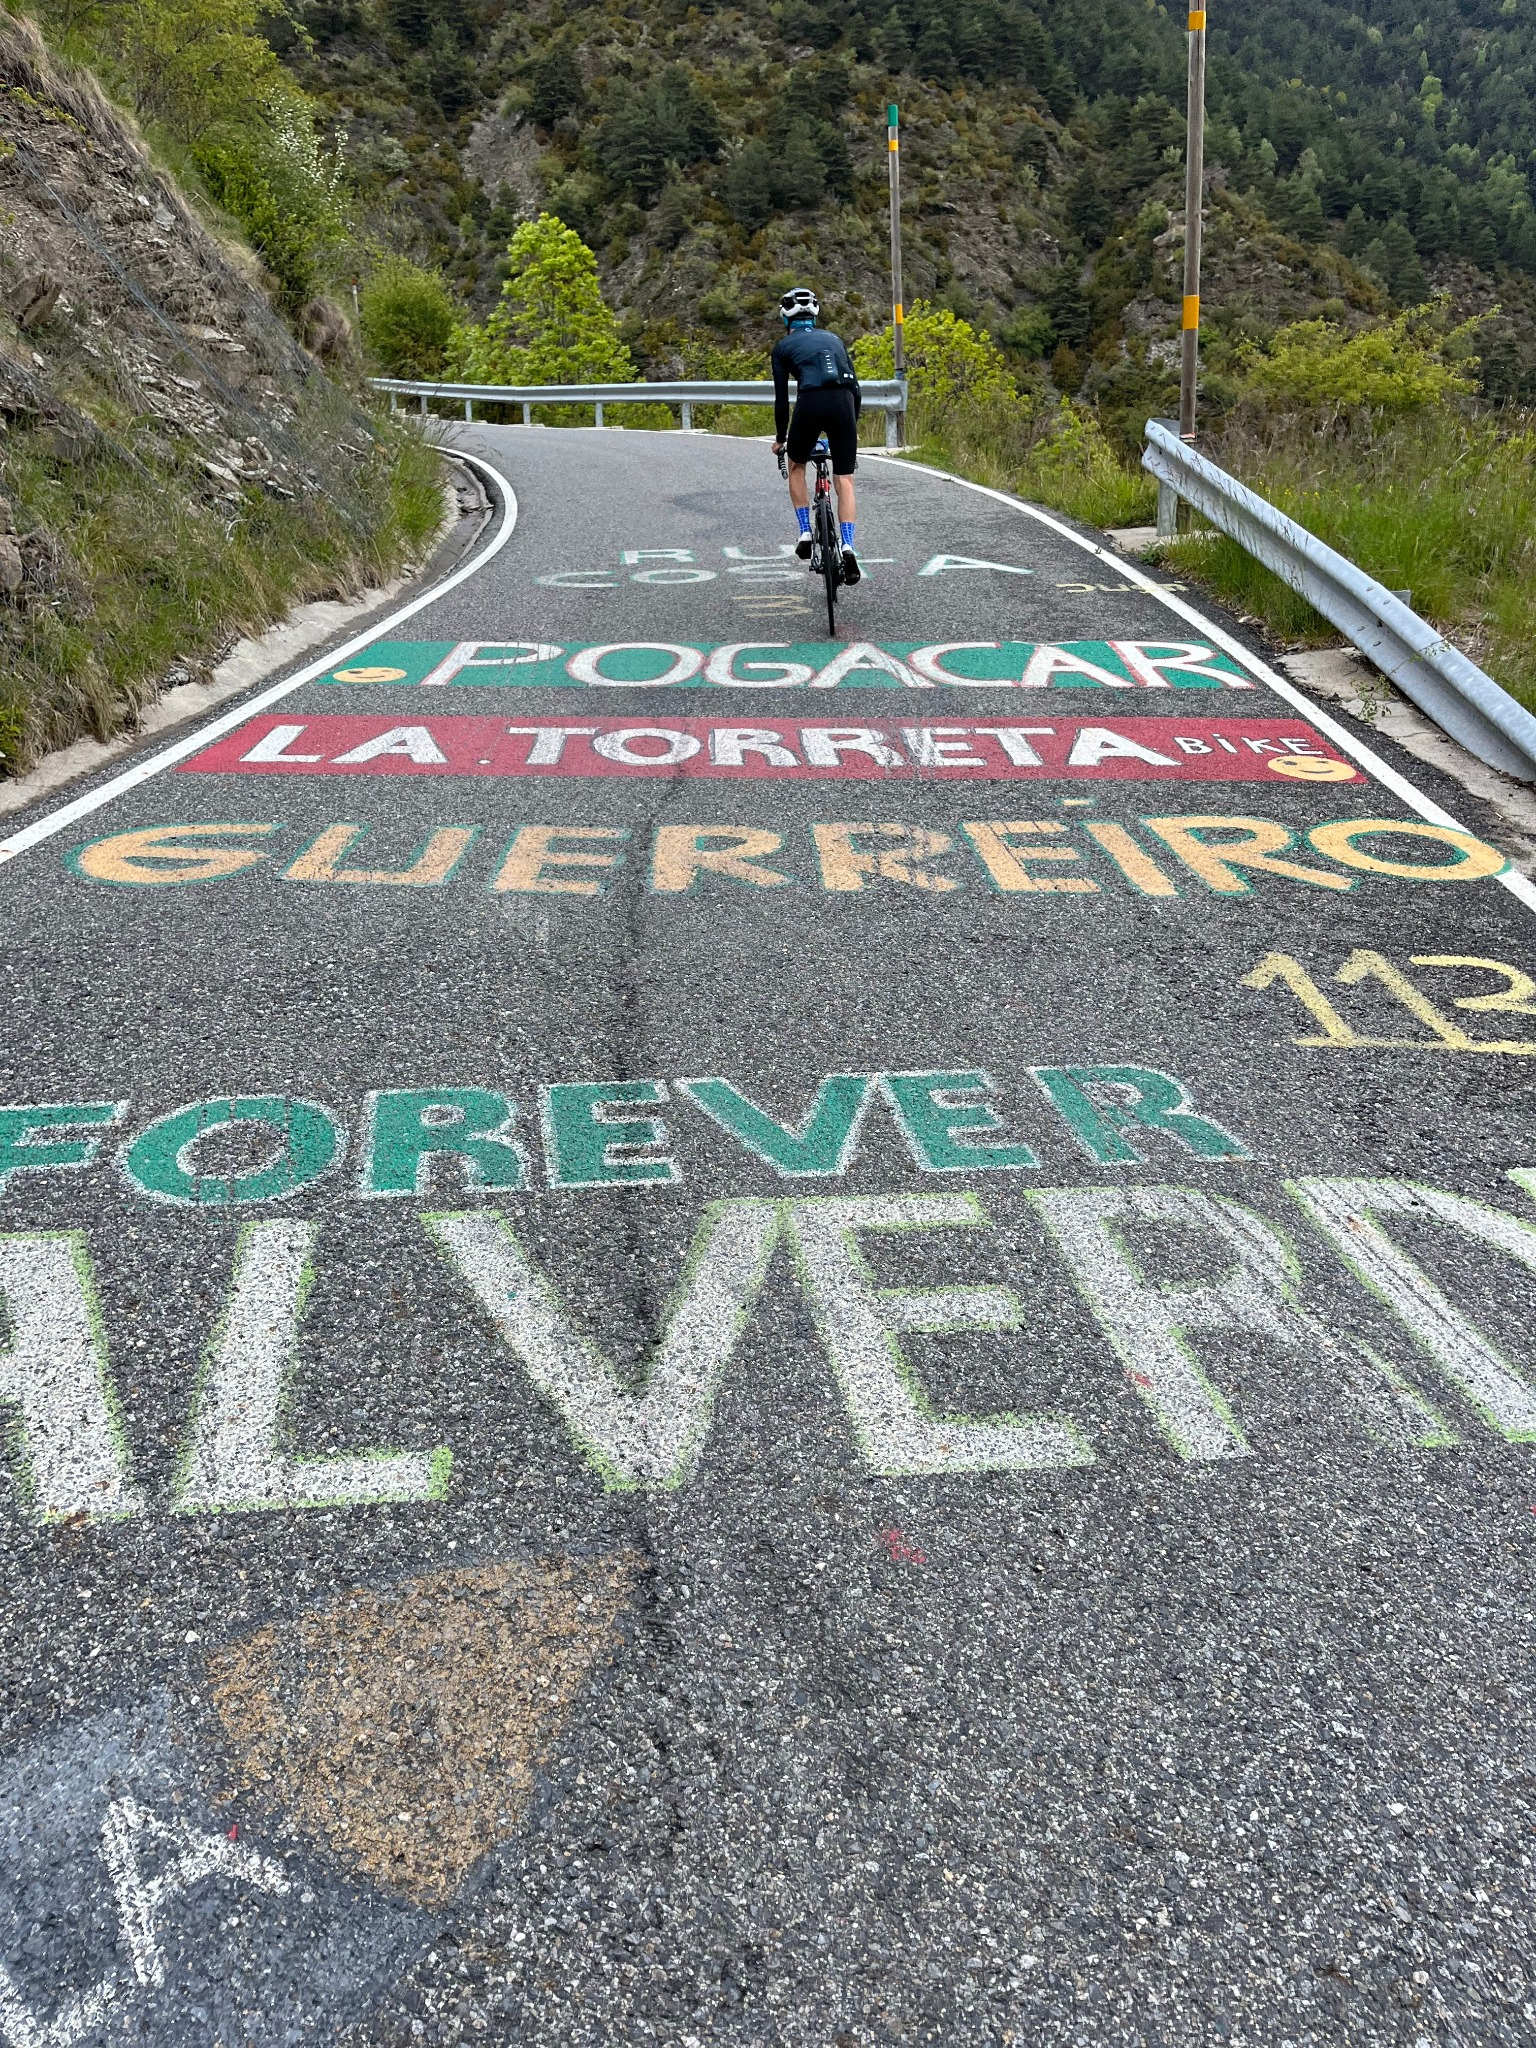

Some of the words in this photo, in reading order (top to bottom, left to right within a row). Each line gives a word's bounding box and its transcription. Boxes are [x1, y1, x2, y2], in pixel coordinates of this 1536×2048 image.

[619, 544, 861, 565] RU
[508, 724, 1183, 768] TORRETA
[0, 1063, 1255, 1205] FOREVER
